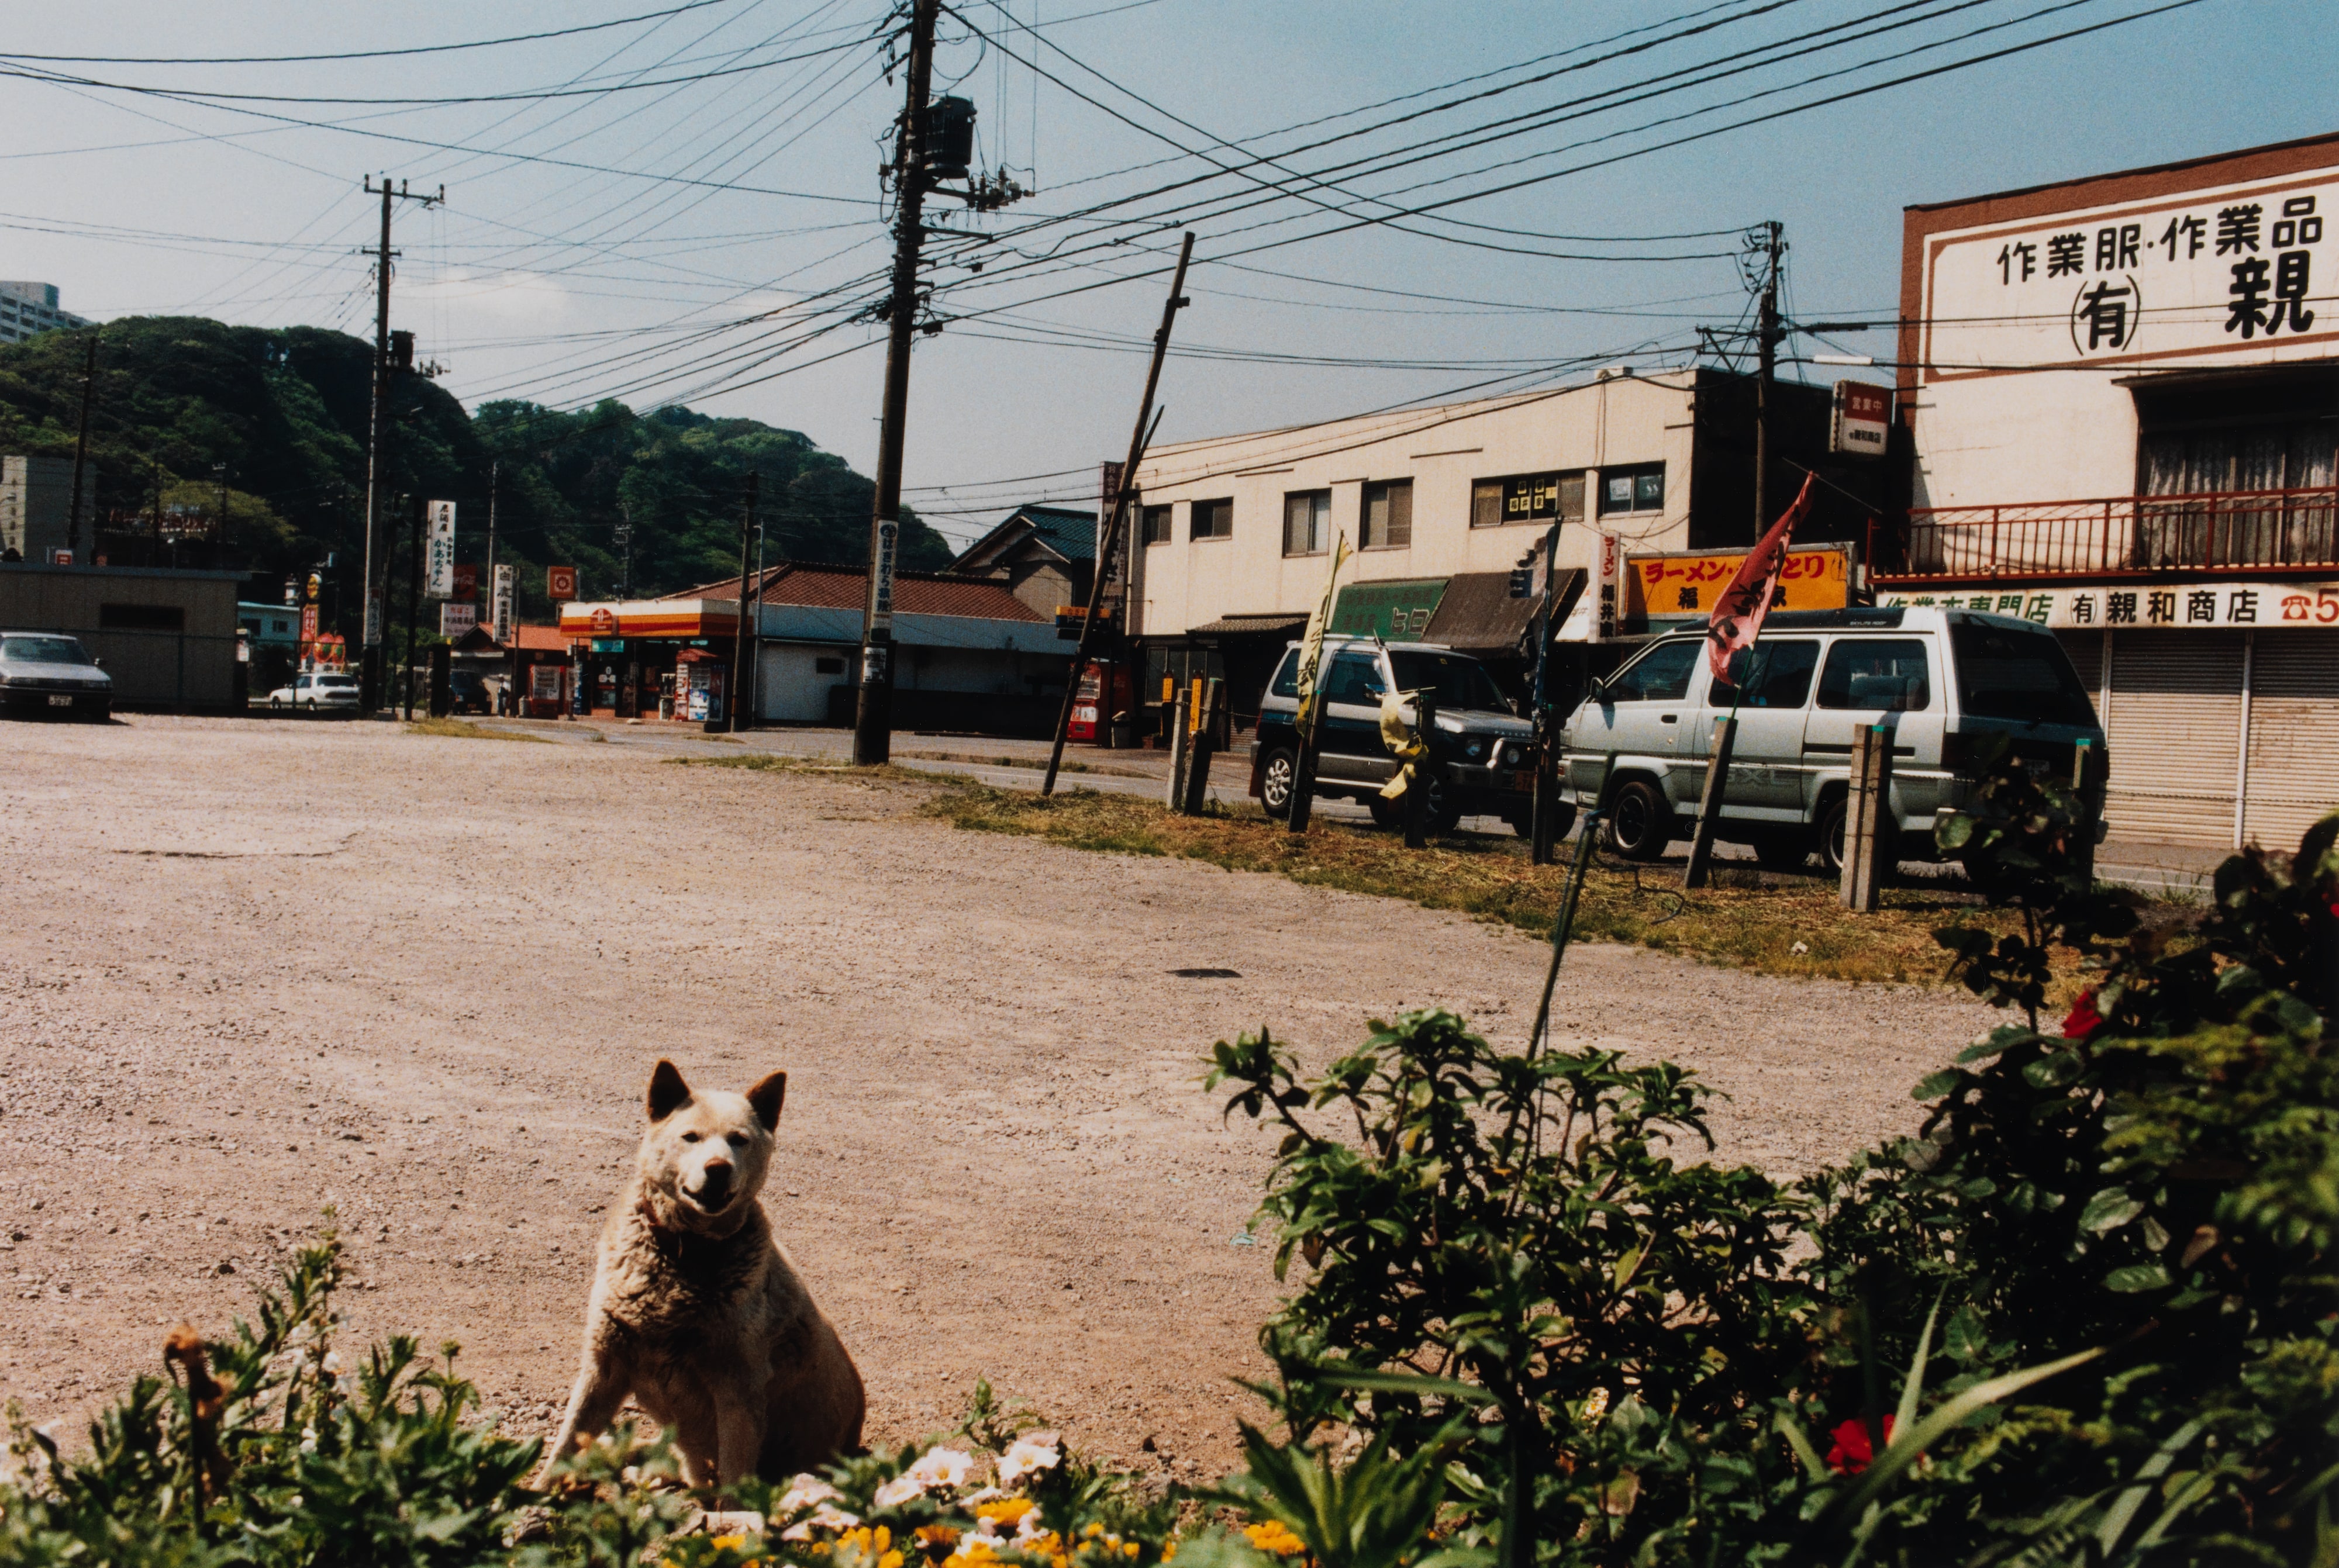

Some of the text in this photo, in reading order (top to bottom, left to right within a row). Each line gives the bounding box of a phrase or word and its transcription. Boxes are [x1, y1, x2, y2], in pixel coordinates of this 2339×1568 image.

[1997, 195, 2323, 285] 作業服・作業品
[1603, 536, 1615, 576] ラーメン
